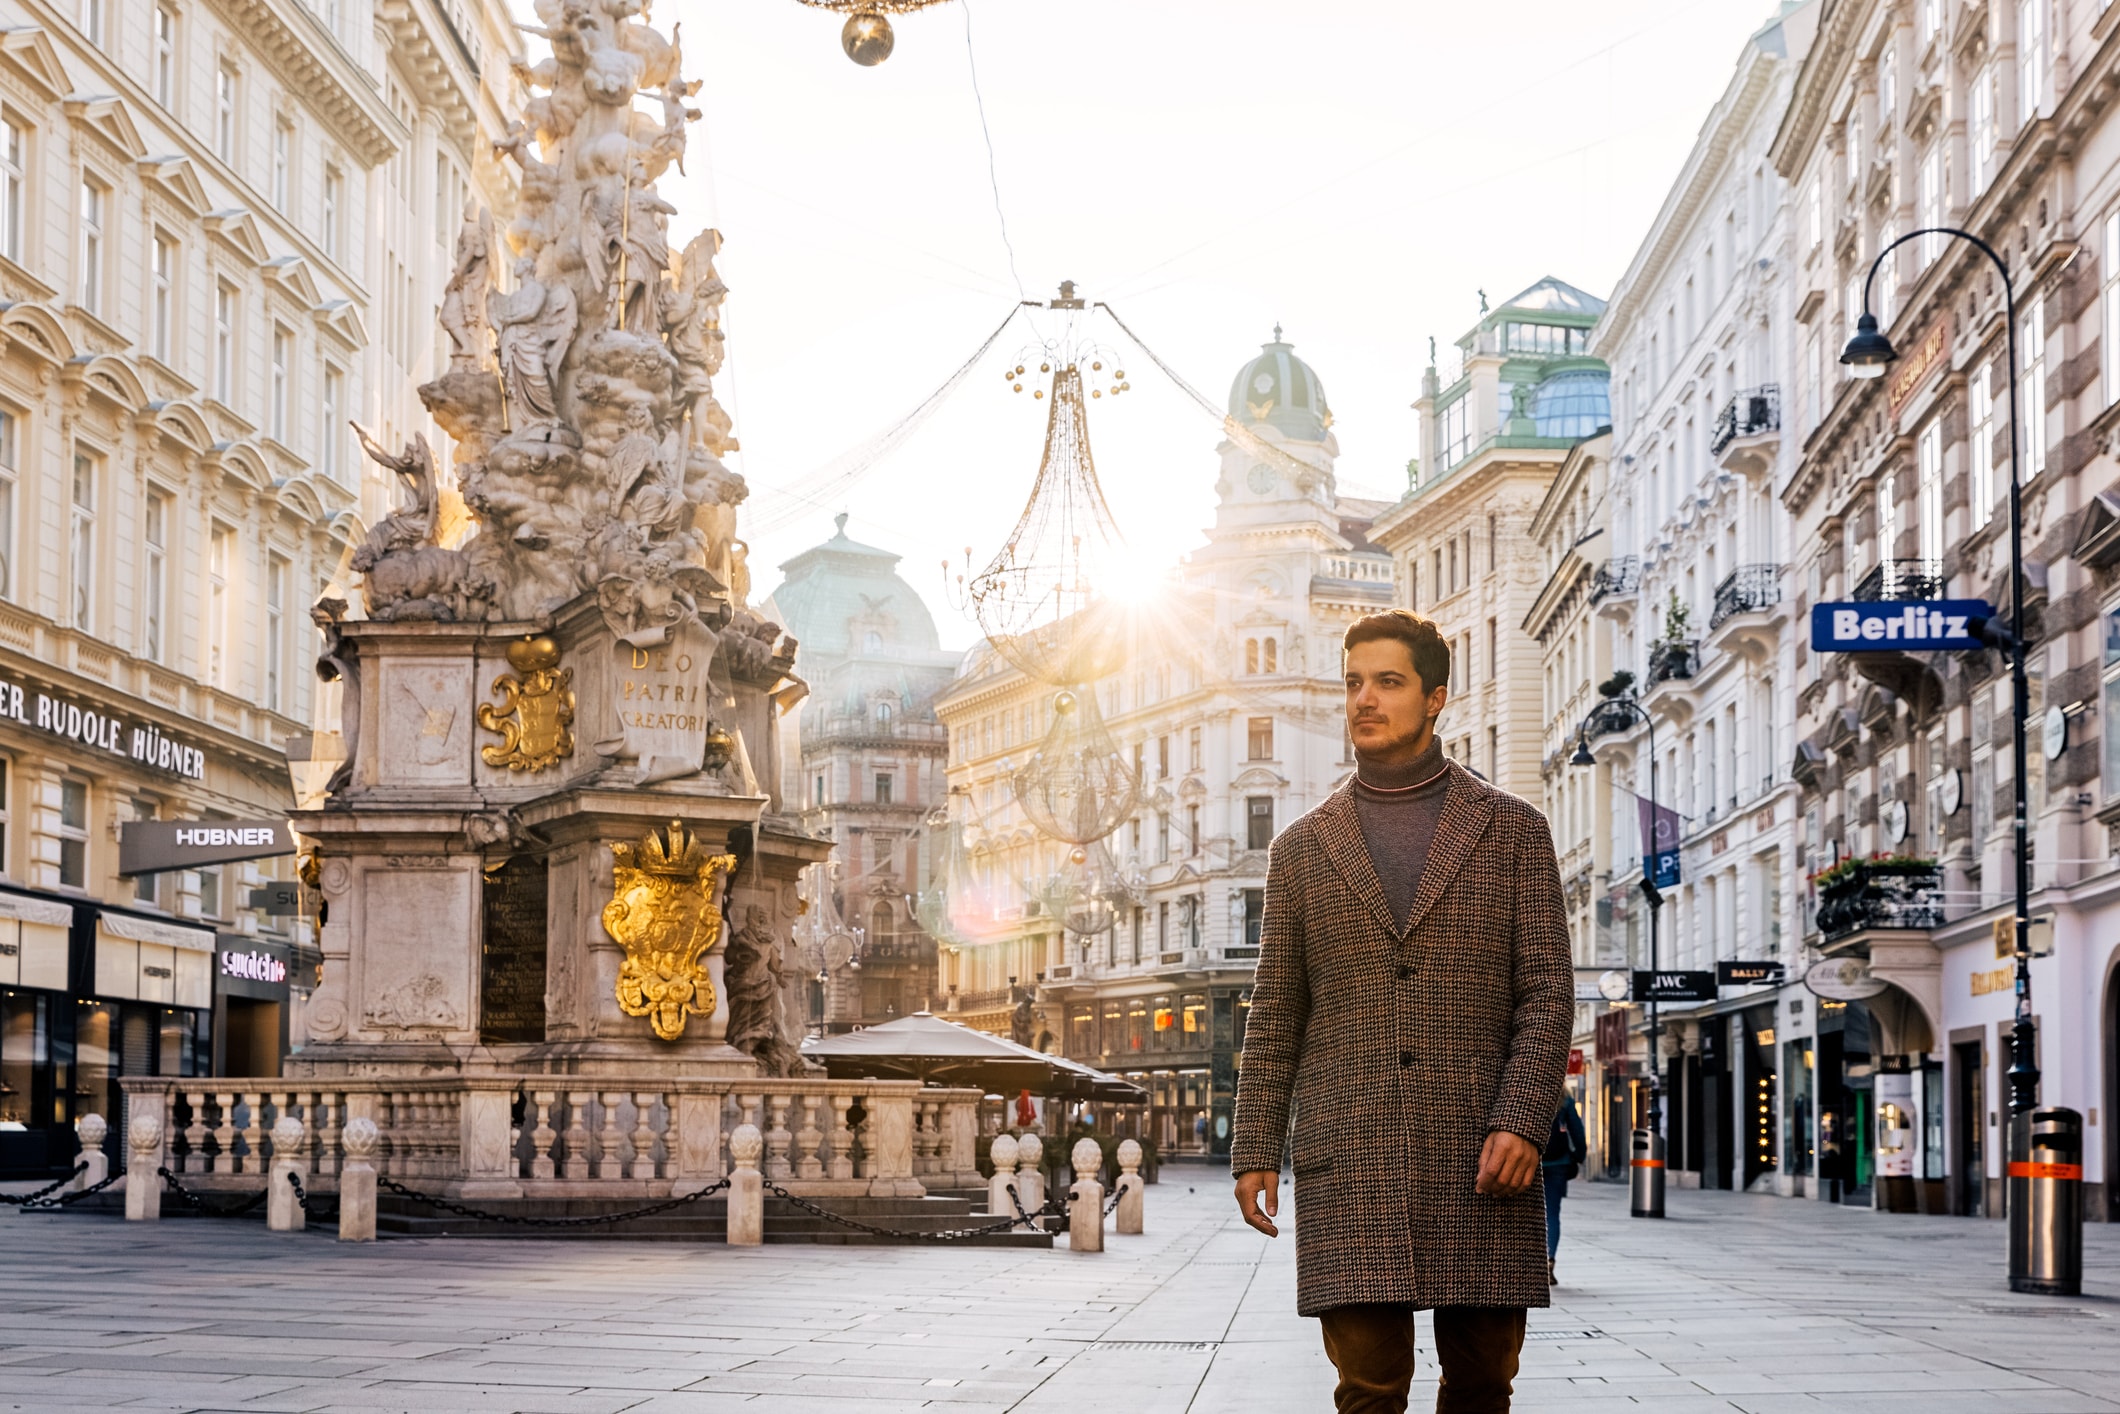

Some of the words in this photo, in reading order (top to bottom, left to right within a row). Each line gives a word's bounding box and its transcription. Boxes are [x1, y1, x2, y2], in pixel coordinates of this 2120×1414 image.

[1833, 606, 1968, 640] Berlitz
[632, 647, 692, 672] DEO
[624, 680, 698, 702] PATRI
[622, 711, 704, 731] CREATORI
[133, 725, 205, 779] HÜBNER
[176, 828, 274, 846] HÜBNER
[1656, 975, 1687, 989] IWC
[1731, 969, 1765, 977] BALLY
